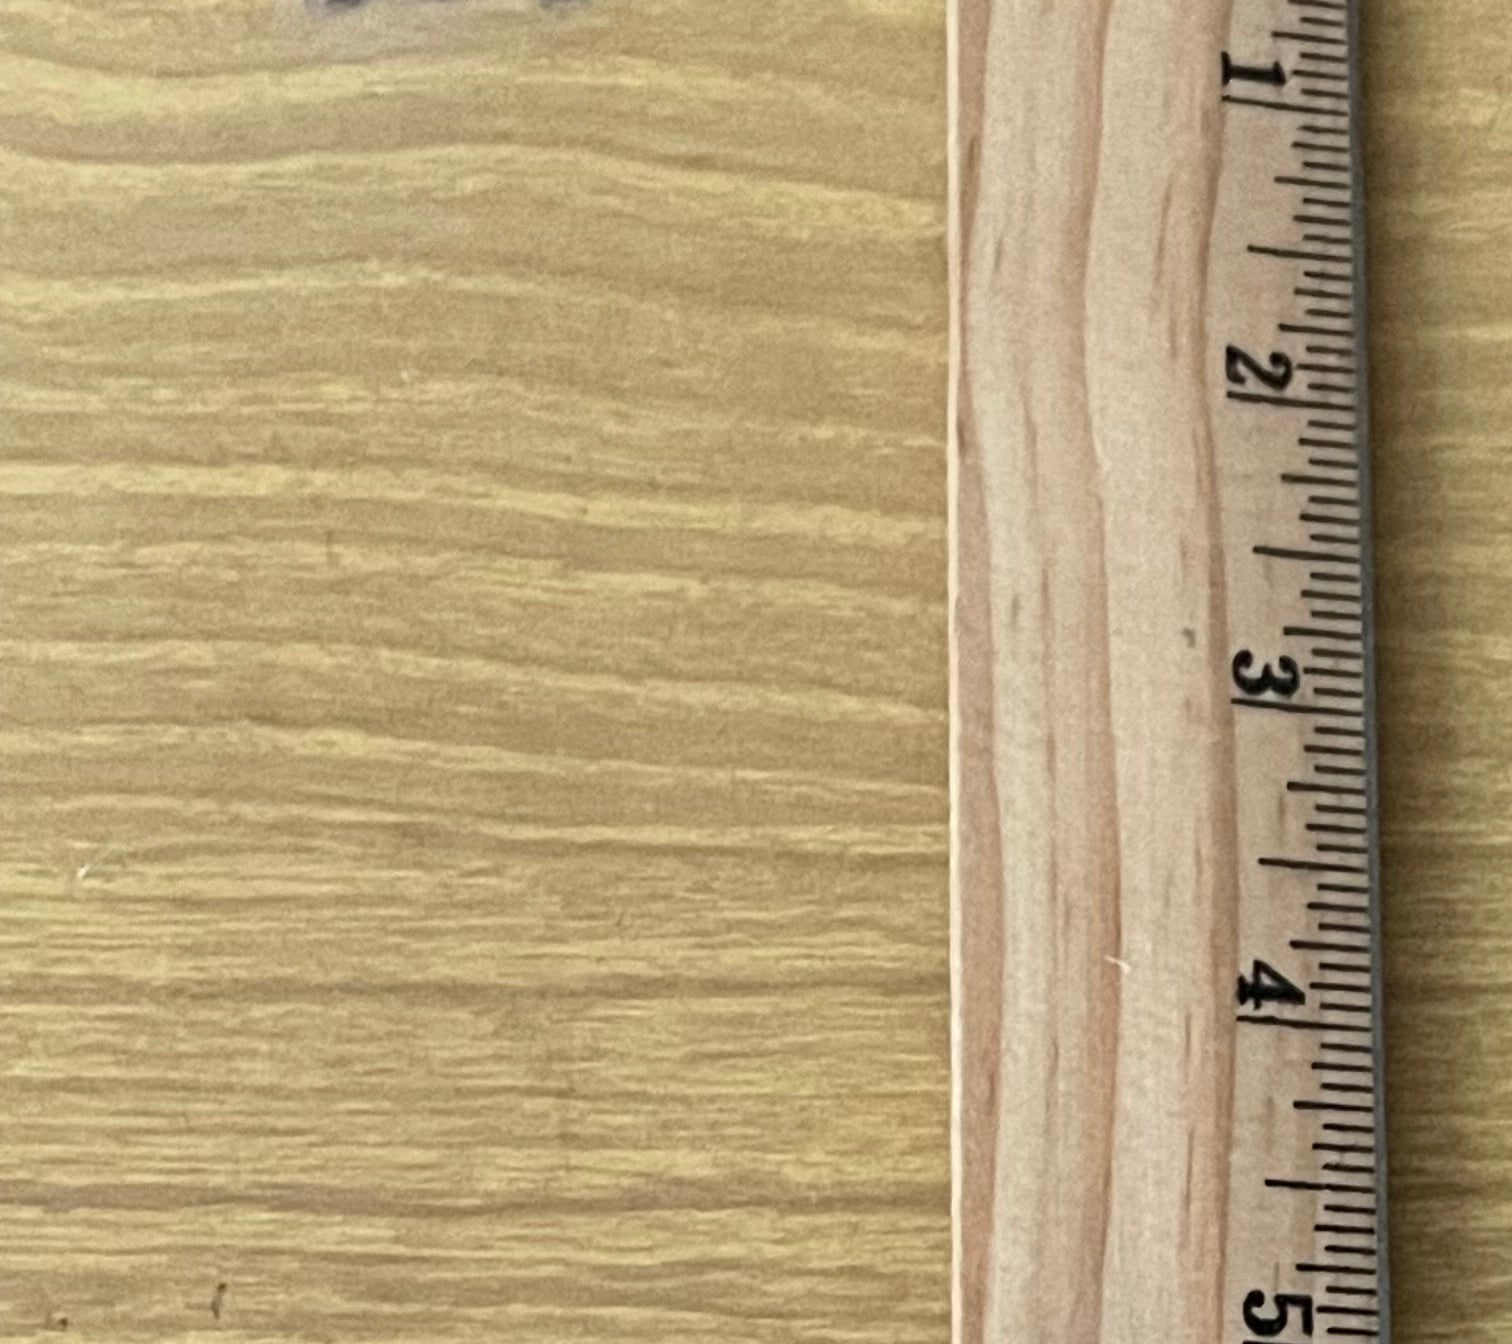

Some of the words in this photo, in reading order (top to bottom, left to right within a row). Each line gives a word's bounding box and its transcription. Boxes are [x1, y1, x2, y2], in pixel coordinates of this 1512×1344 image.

[1221, 51, 1287, 87] 1
[1225, 344, 1294, 391] 2
[1231, 649, 1300, 697] 3
[1235, 959, 1306, 1010] 4
[1242, 1289, 1314, 1338] 5
